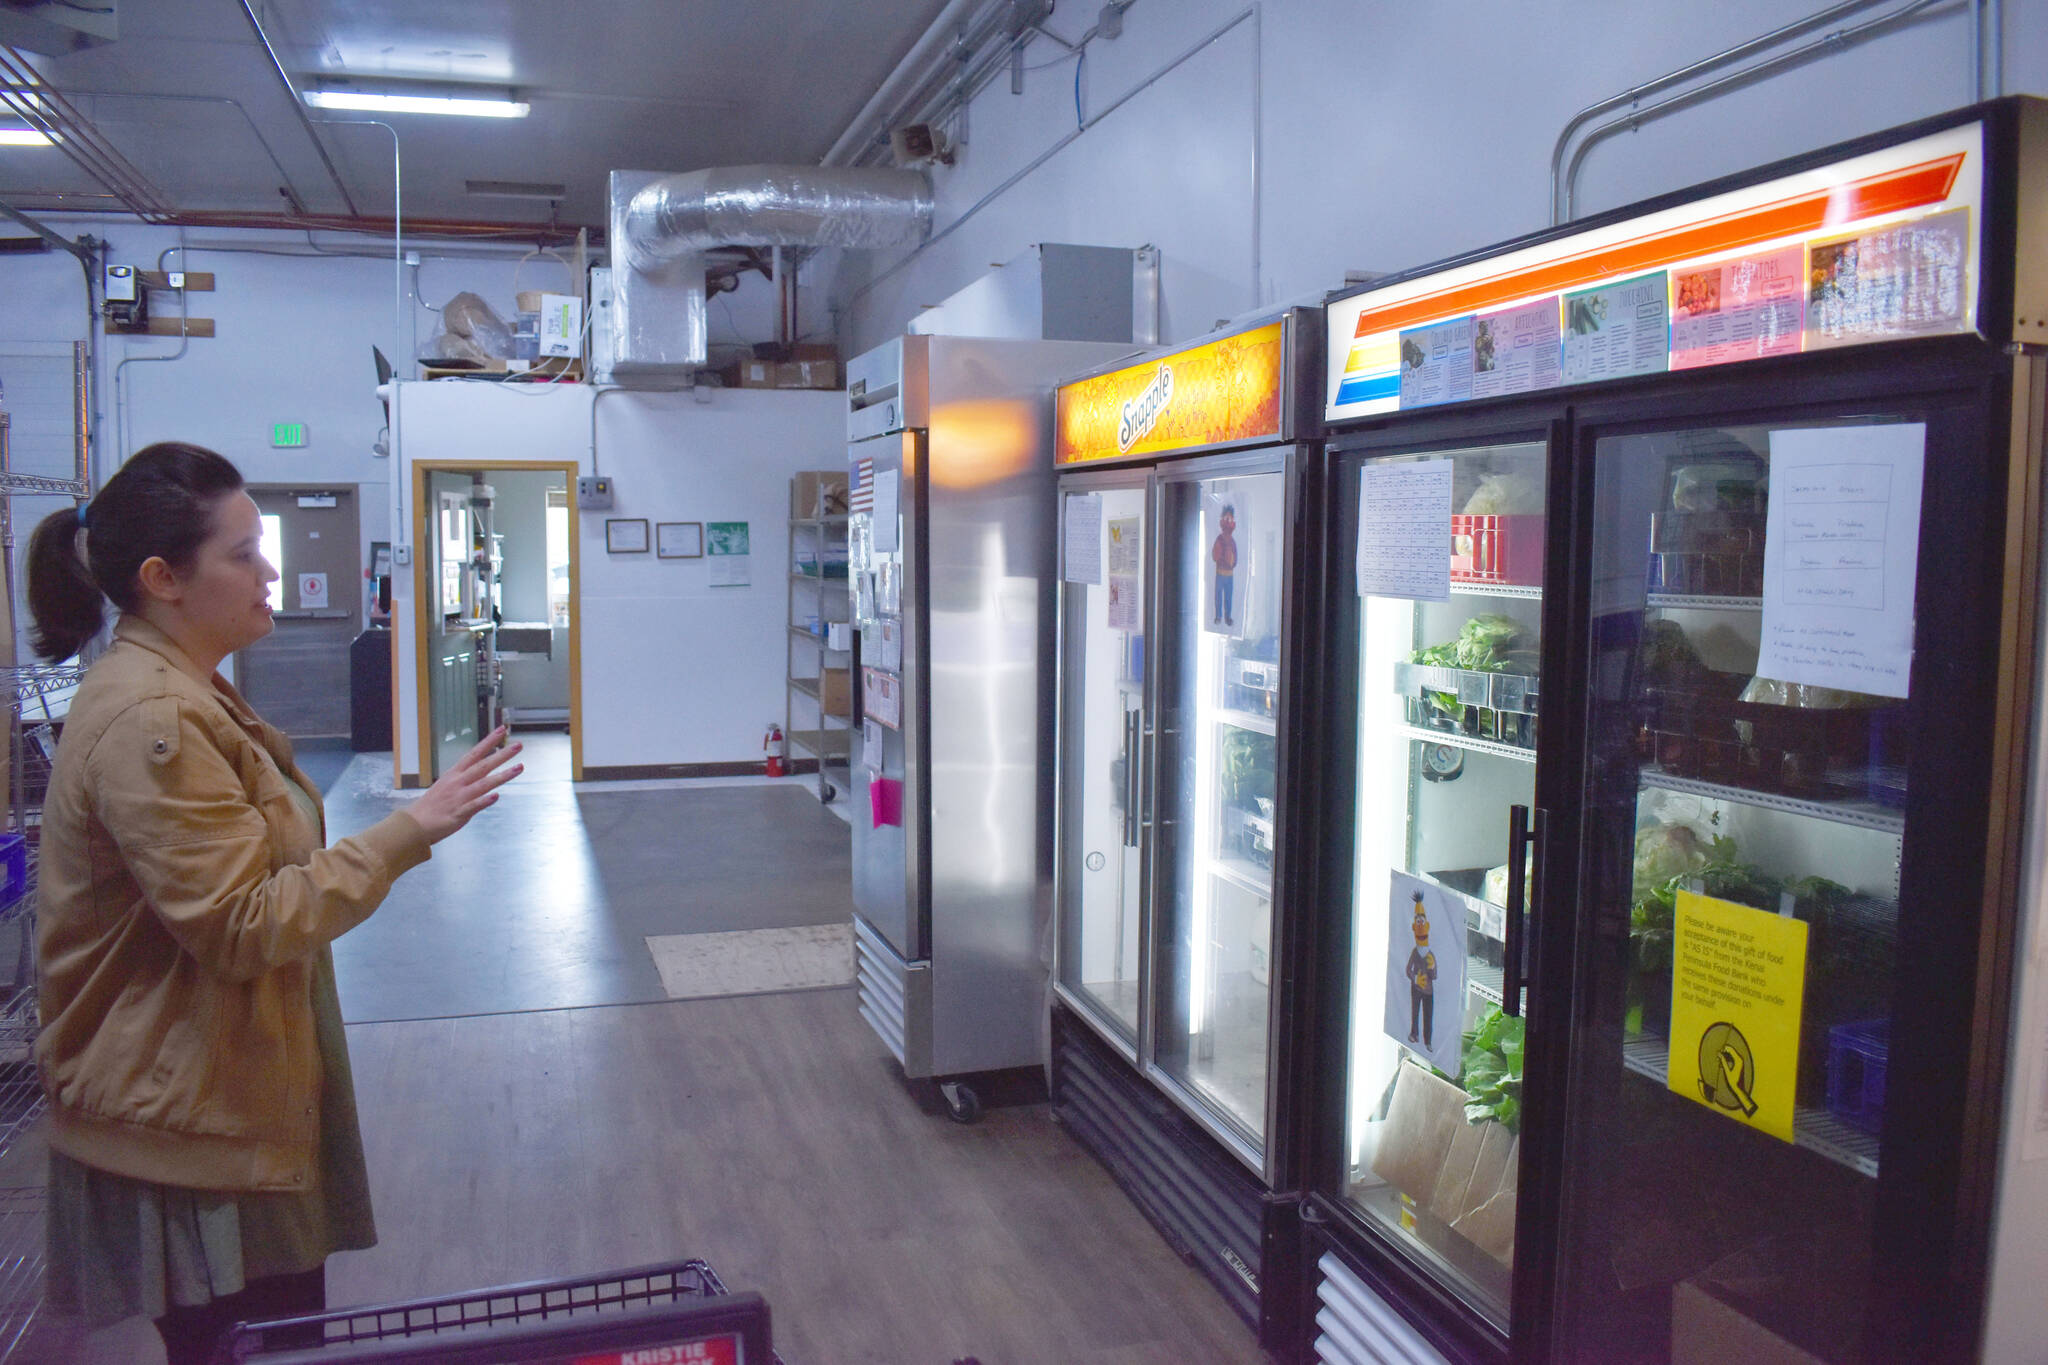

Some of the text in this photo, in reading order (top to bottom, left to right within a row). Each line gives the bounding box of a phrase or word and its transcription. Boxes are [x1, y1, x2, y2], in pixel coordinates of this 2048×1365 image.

[1731, 259, 1779, 282] TOATOES
[1121, 365, 1169, 444] Snapple
[274, 423, 303, 445] EXIT
[1684, 915, 1705, 929] Please
[1705, 920, 1714, 932] be
[1716, 926, 1737, 938] aware
[1714, 949, 1730, 962] from
[1731, 955, 1743, 965] the
[1745, 959, 1765, 973] Kenai
[1720, 939, 1728, 948] of
[1743, 946, 1755, 958] gift
[1757, 949, 1766, 959] of
[1767, 951, 1784, 965] food
[1683, 952, 1711, 969] Peninsula
[1713, 962, 1730, 976] Food
[1731, 968, 1748, 981] Bank
[1681, 977, 1752, 1009] the same provision on
[1708, 974, 1727, 987] these
[1727, 981, 1762, 999] donations
[1763, 993, 1785, 1006] under
[621, 1341, 706, 1365] KRISTIE
